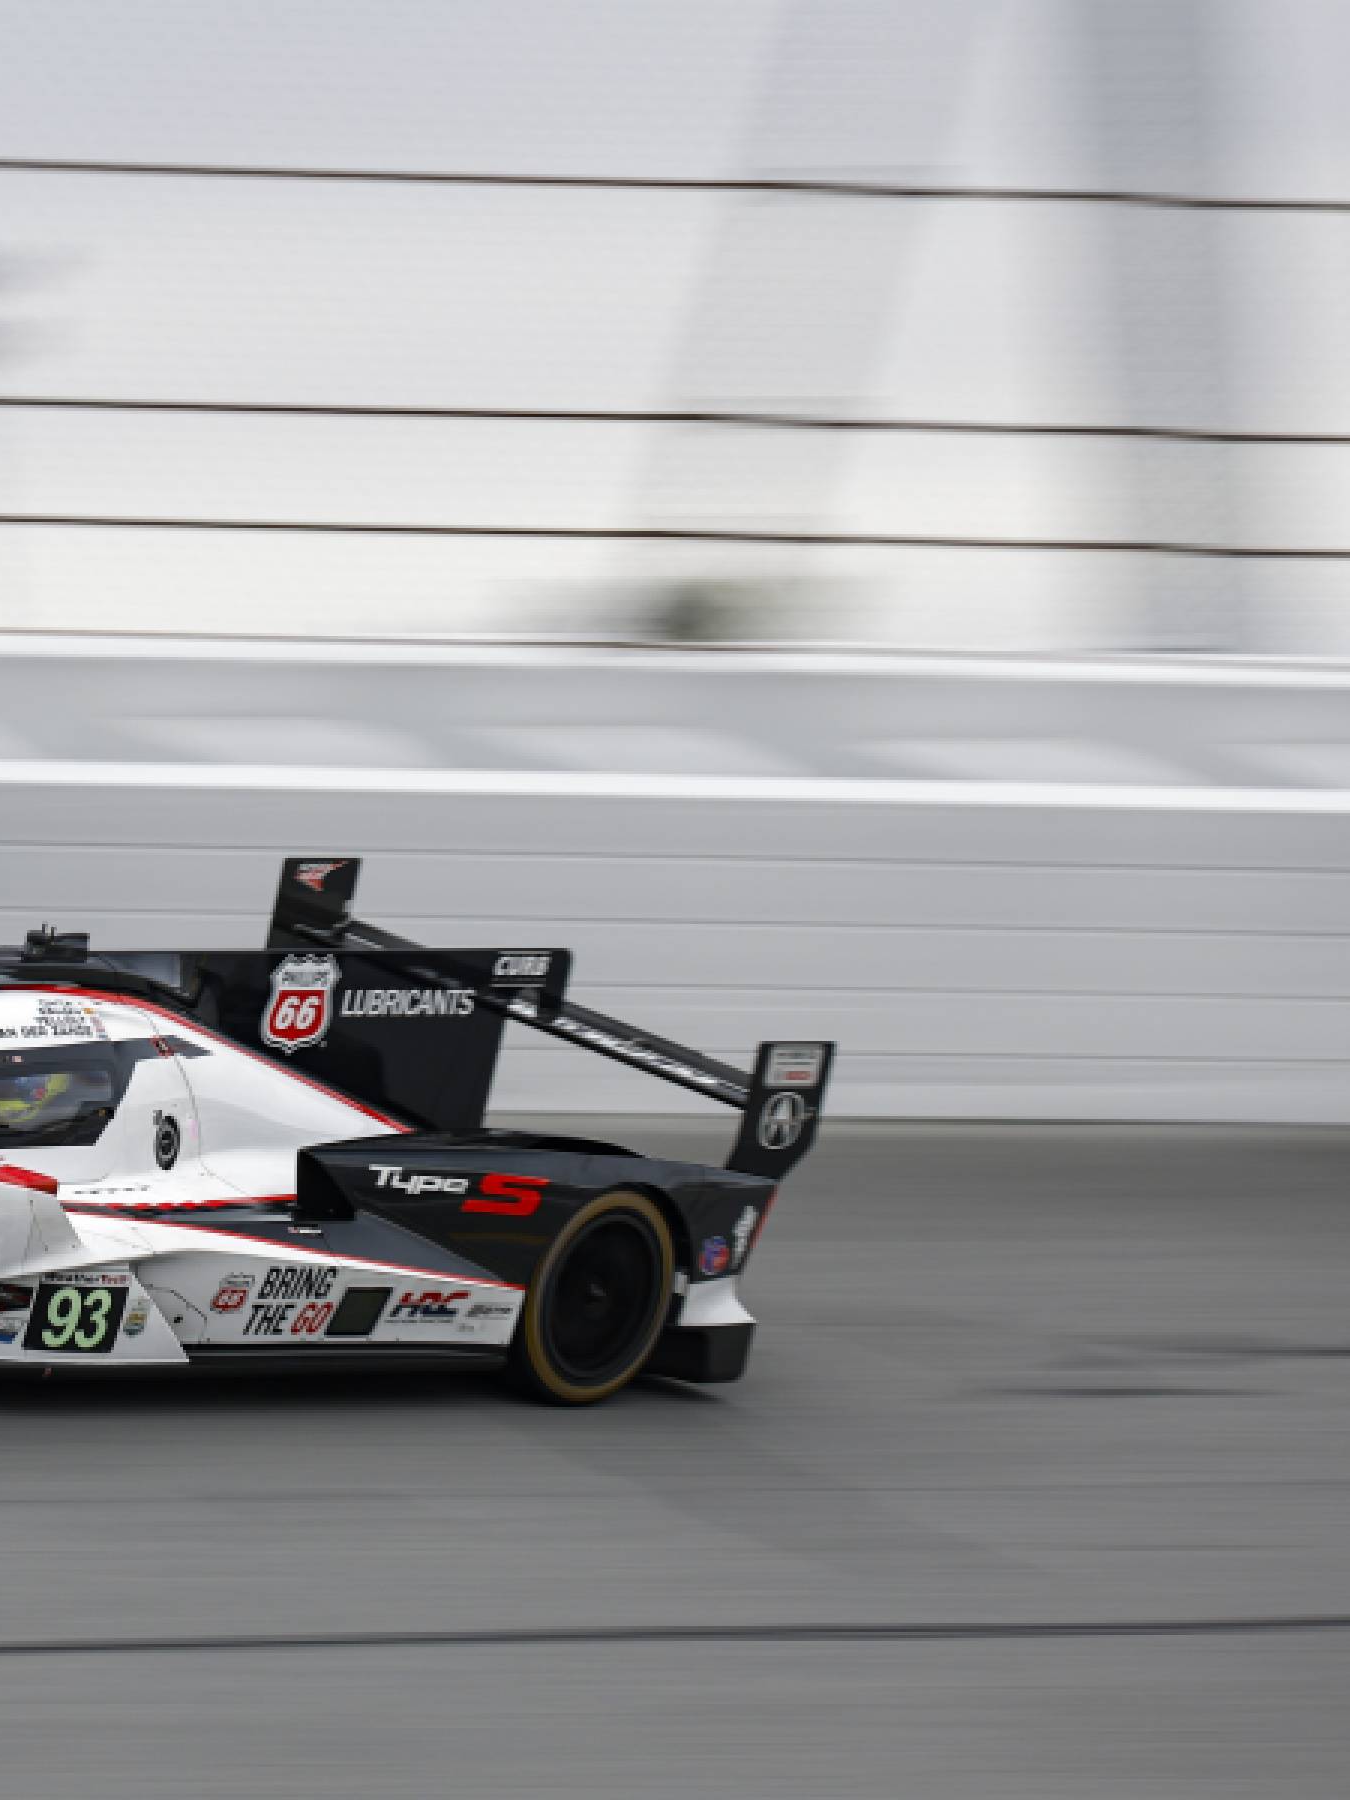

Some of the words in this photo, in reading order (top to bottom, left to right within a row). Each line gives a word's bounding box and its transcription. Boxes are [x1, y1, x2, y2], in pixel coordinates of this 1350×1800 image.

[274, 995, 320, 1030] 66
[339, 989, 476, 1016] LUBRICANTS
[369, 1163, 470, 1195] Type
[461, 1172, 551, 1216] S
[217, 1293, 244, 1306] 66
[257, 1267, 338, 1300] BRING
[41, 1288, 112, 1348] 93
[242, 1304, 297, 1336] THE
[290, 1302, 334, 1335] GO
[389, 1289, 470, 1318] HRC
